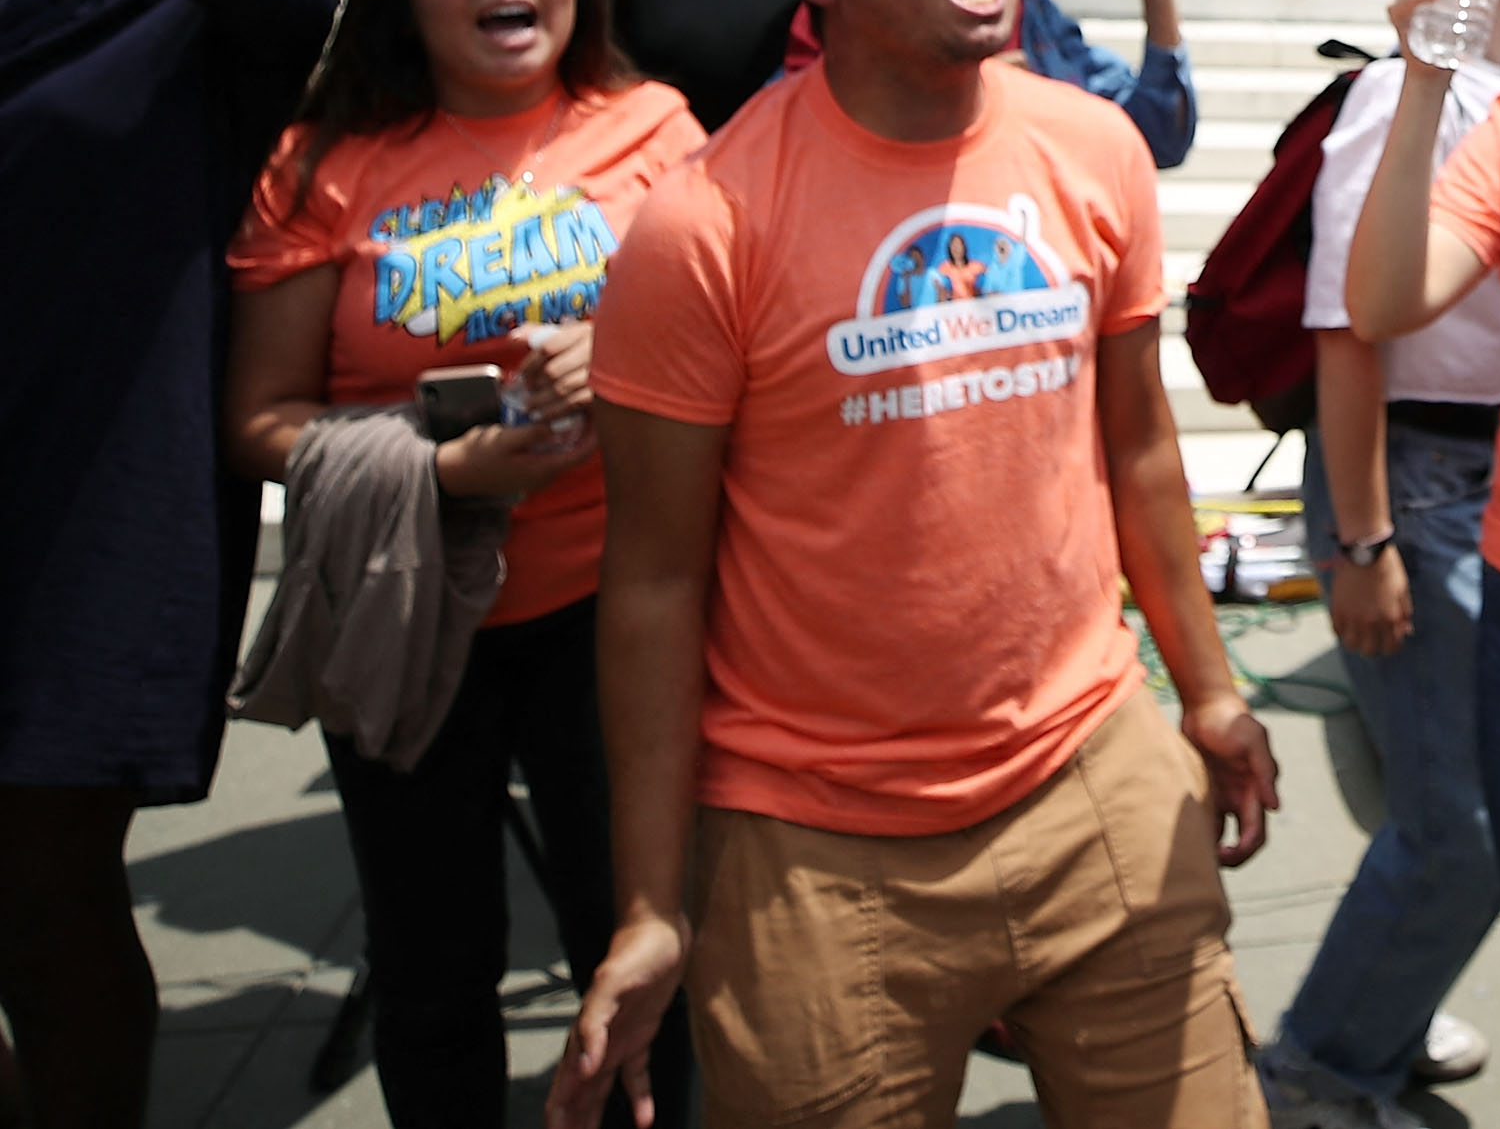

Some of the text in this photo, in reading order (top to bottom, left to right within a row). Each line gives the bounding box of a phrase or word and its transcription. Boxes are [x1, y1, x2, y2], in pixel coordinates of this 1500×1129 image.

[369, 185, 497, 243] CLEAN
[374, 202, 620, 327] DREAM
[465, 298, 531, 345] ACT
[841, 305, 1079, 362] United We Dream
